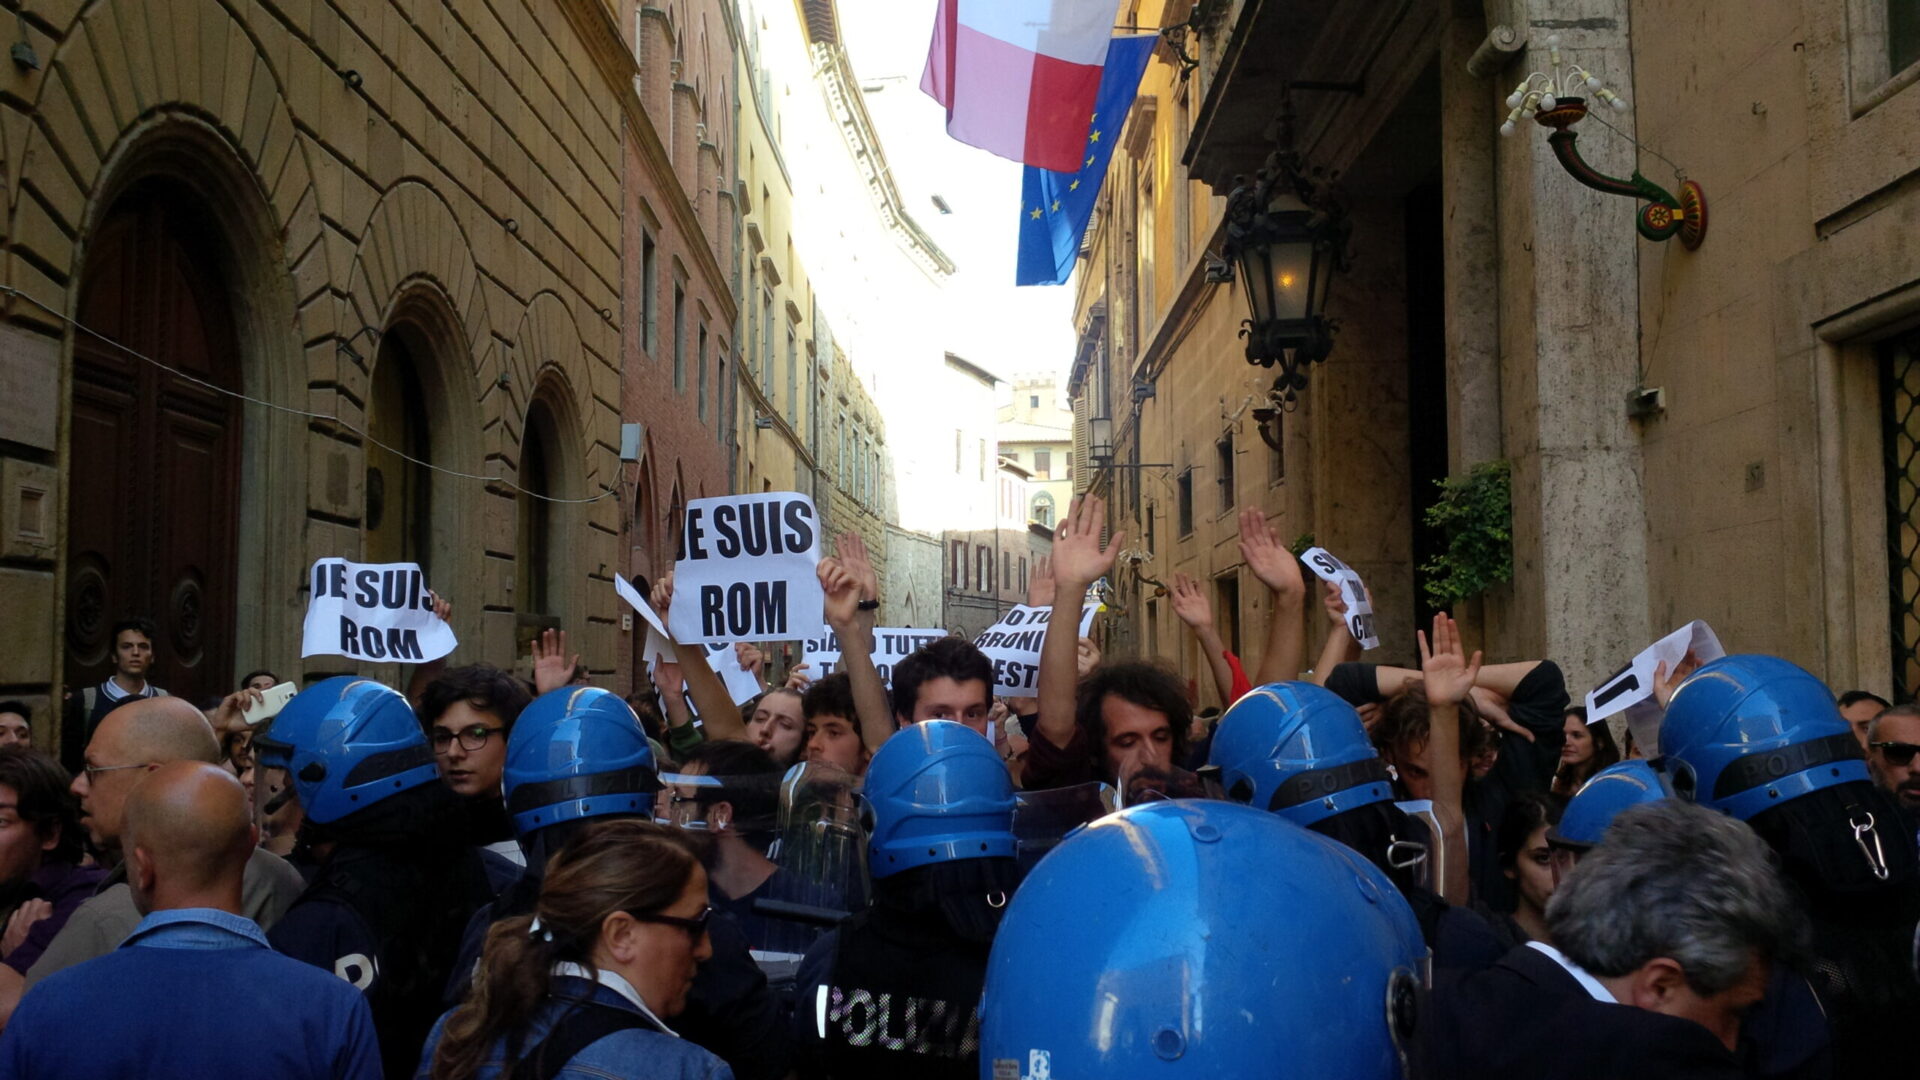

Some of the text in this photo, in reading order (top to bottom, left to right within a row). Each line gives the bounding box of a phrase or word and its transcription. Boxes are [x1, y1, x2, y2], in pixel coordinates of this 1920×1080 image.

[713, 500, 813, 559] SUIS
[315, 563, 347, 600] JE
[700, 580, 787, 637] ROM
[340, 614, 424, 659] ROM
